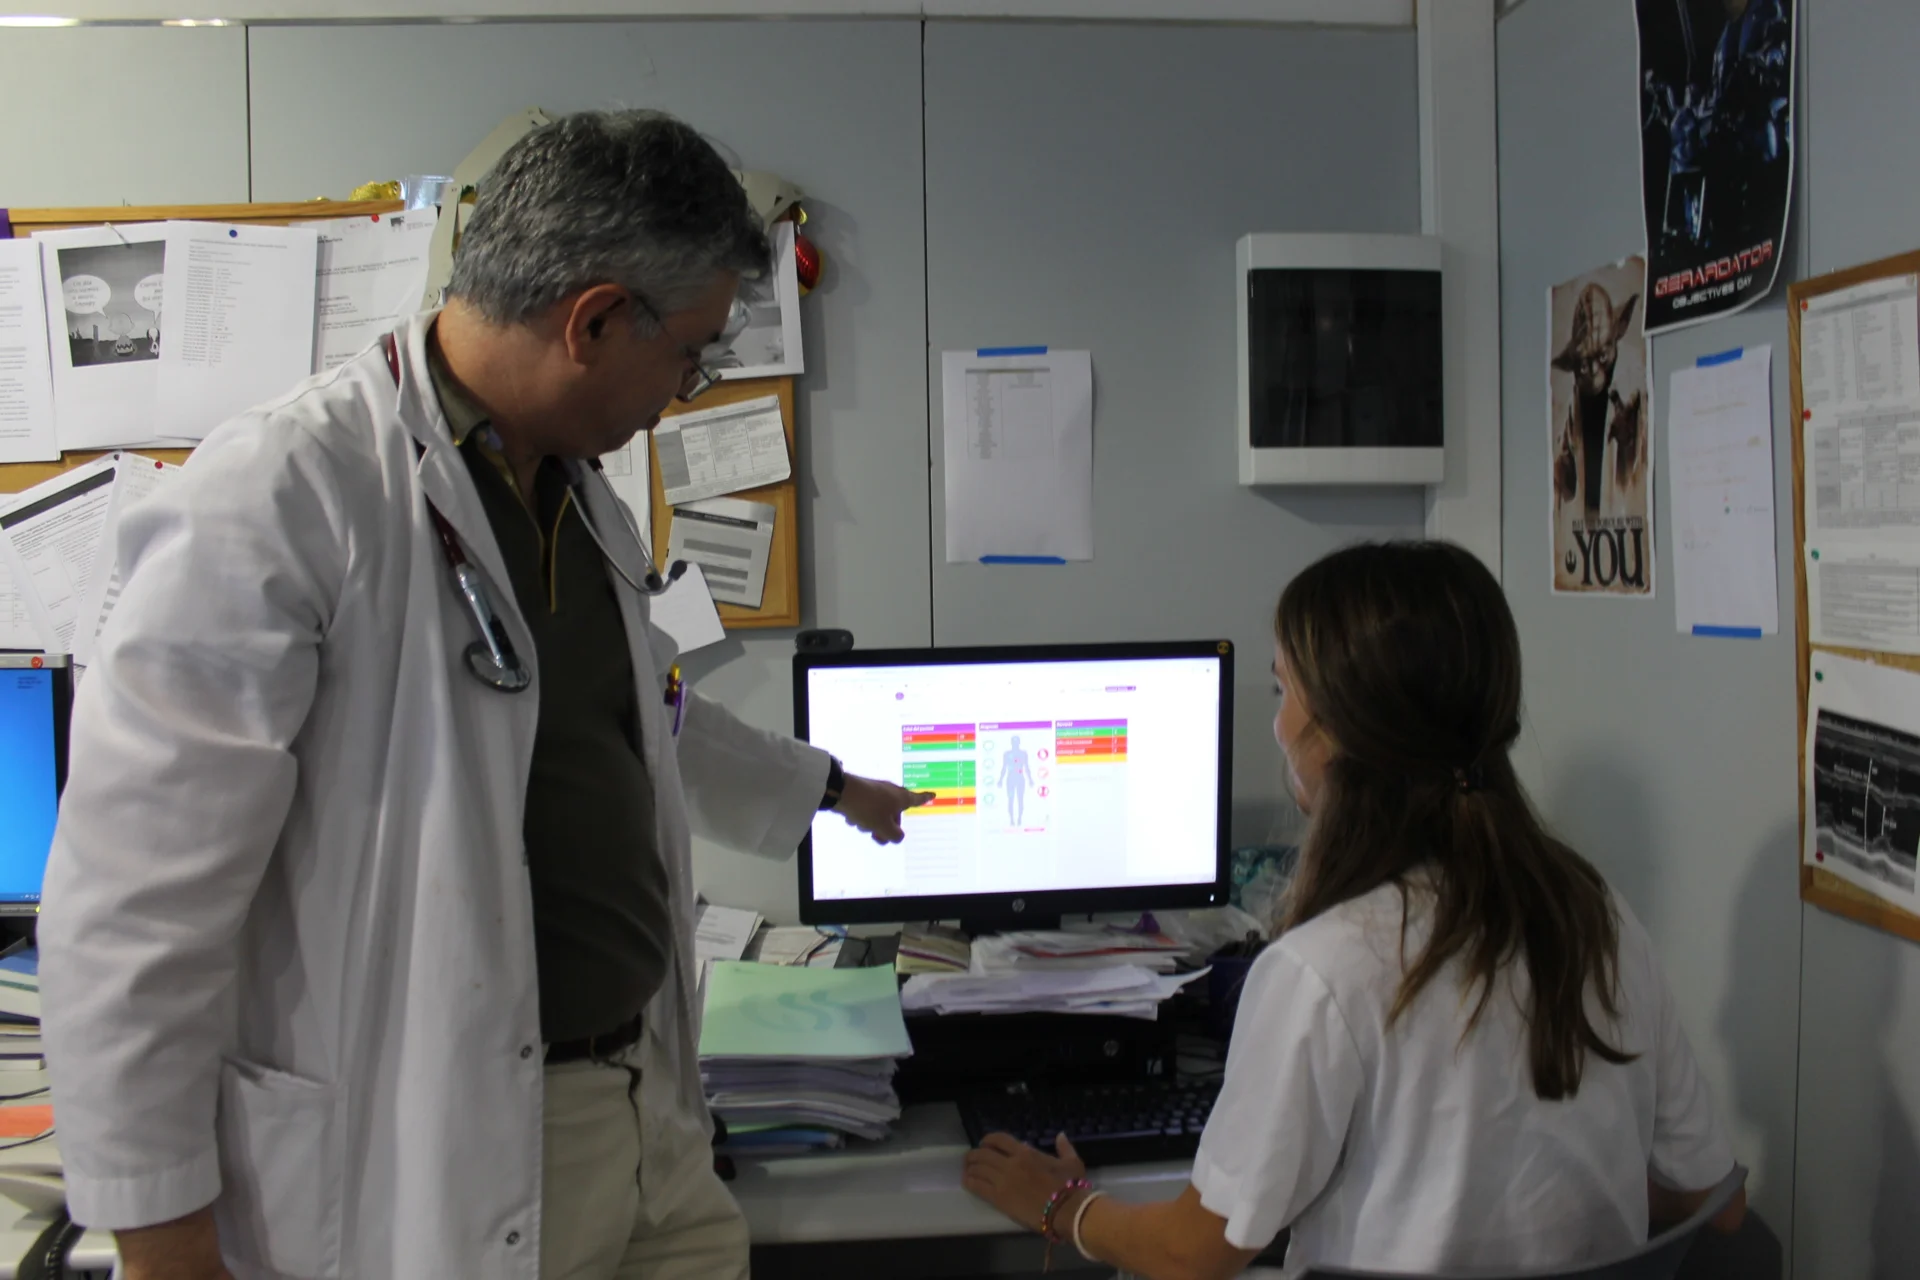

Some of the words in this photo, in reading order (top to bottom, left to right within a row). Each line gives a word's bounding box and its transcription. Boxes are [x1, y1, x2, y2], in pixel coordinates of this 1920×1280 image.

[1654, 238, 1773, 298] GERARDATOR
[1672, 281, 1735, 309] OBJECTIVES
[1736, 274, 1753, 291] DAY
[1572, 528, 1645, 587] YOU
